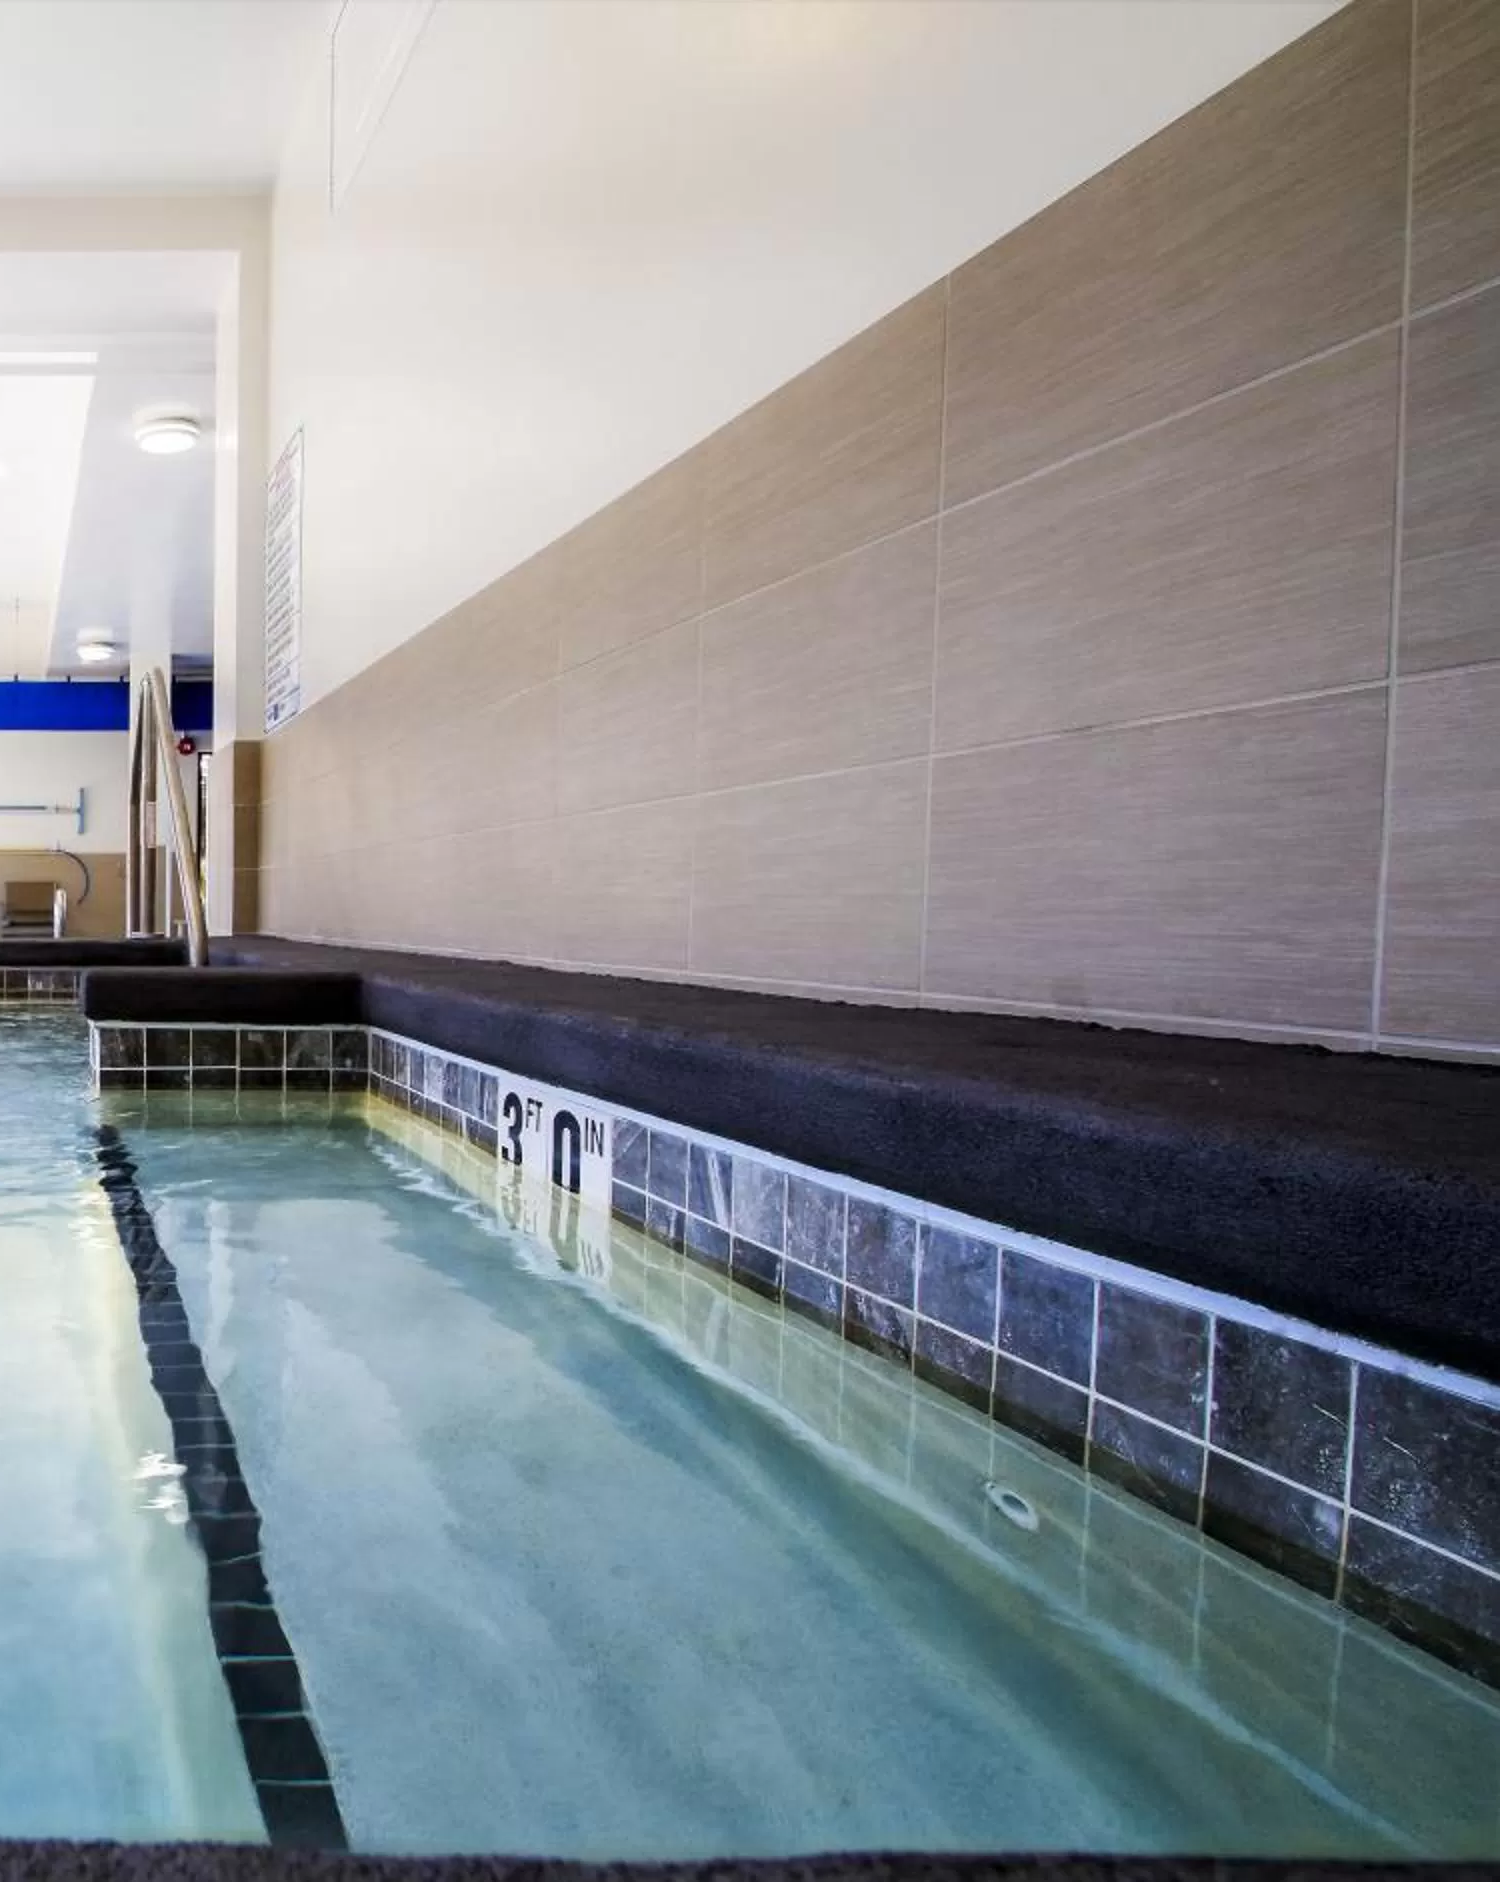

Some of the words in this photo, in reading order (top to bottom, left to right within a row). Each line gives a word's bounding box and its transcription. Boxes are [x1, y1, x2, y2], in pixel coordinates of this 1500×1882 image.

[502, 1092, 523, 1166] 3
[525, 1097, 543, 1132] FT
[585, 1117, 604, 1157] IN
